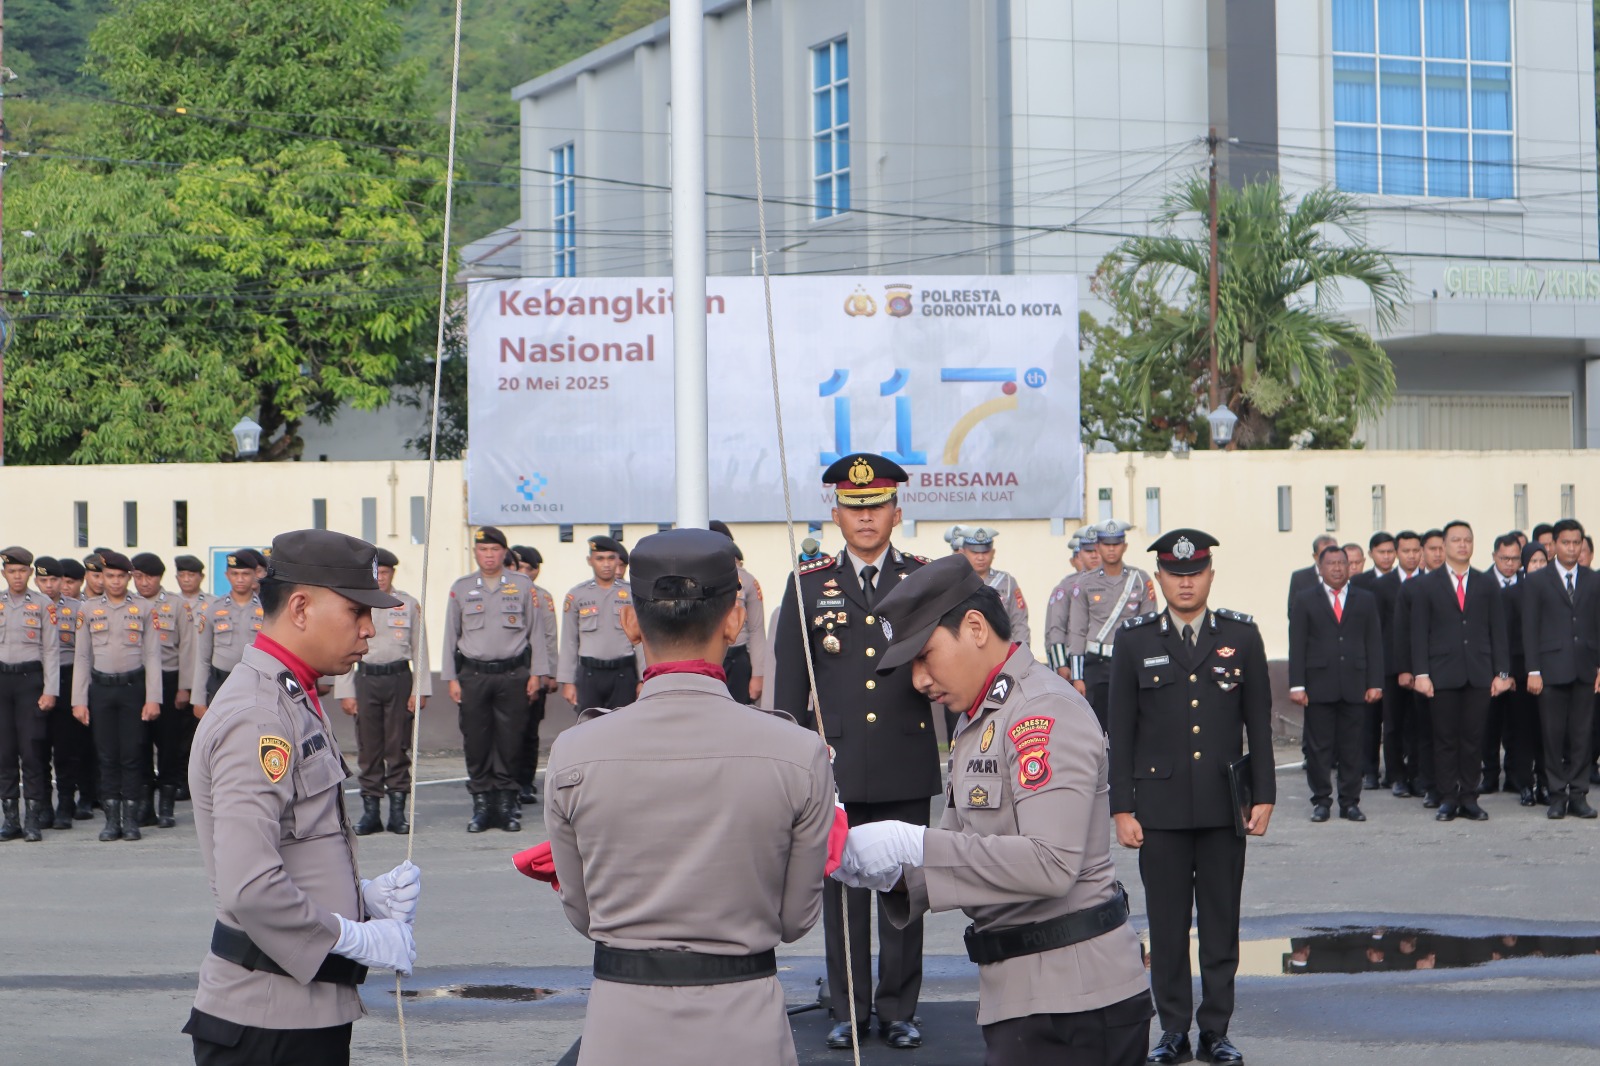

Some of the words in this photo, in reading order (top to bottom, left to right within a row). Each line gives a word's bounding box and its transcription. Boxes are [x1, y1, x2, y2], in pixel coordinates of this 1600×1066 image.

[1444, 265, 1539, 295] GEREJA
[921, 290, 1001, 303] POLRESTA
[500, 288, 725, 323] Kebangkin
[921, 303, 1016, 317] GORONTALO
[1021, 303, 1062, 316] KOTA
[500, 334, 654, 363] Nasional
[498, 377, 520, 391] 20
[526, 376, 560, 391] Mei
[565, 376, 609, 390] 2025
[819, 367, 1018, 466] 117
[1026, 372, 1045, 385] th
[921, 472, 1019, 487] BERSAMA
[903, 491, 977, 503] INDONESIA
[982, 490, 1015, 502] KUAT
[500, 503, 564, 512] KOMDIGI
[1011, 718, 1049, 738] POLRESTA
[966, 759, 998, 773] POLRI
